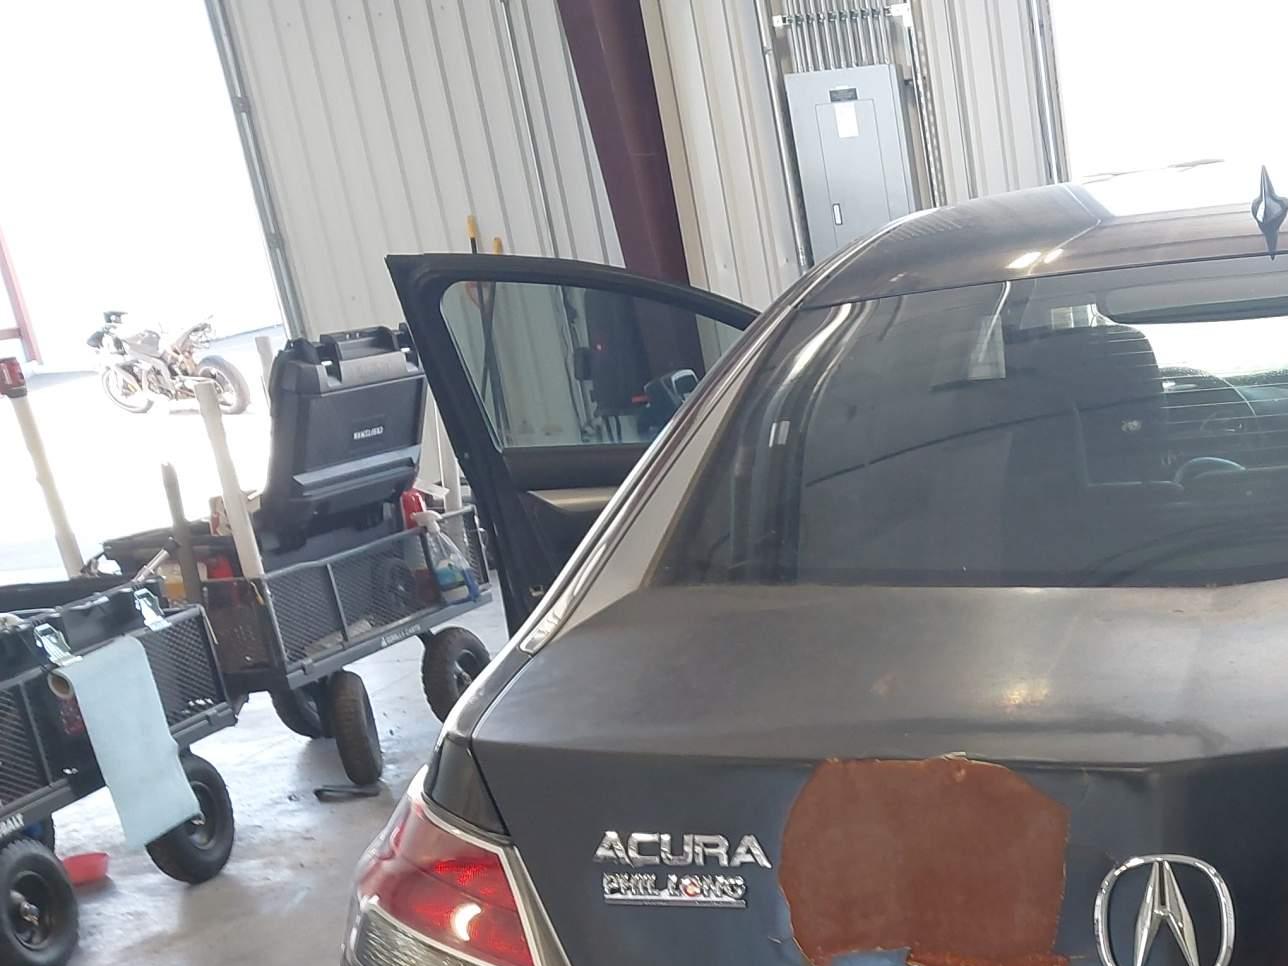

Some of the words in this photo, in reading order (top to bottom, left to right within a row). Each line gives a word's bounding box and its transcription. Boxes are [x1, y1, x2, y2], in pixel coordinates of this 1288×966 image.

[592, 830, 773, 869] ACURA
[602, 871, 660, 897] PHIL
[666, 872, 747, 899] LONG
